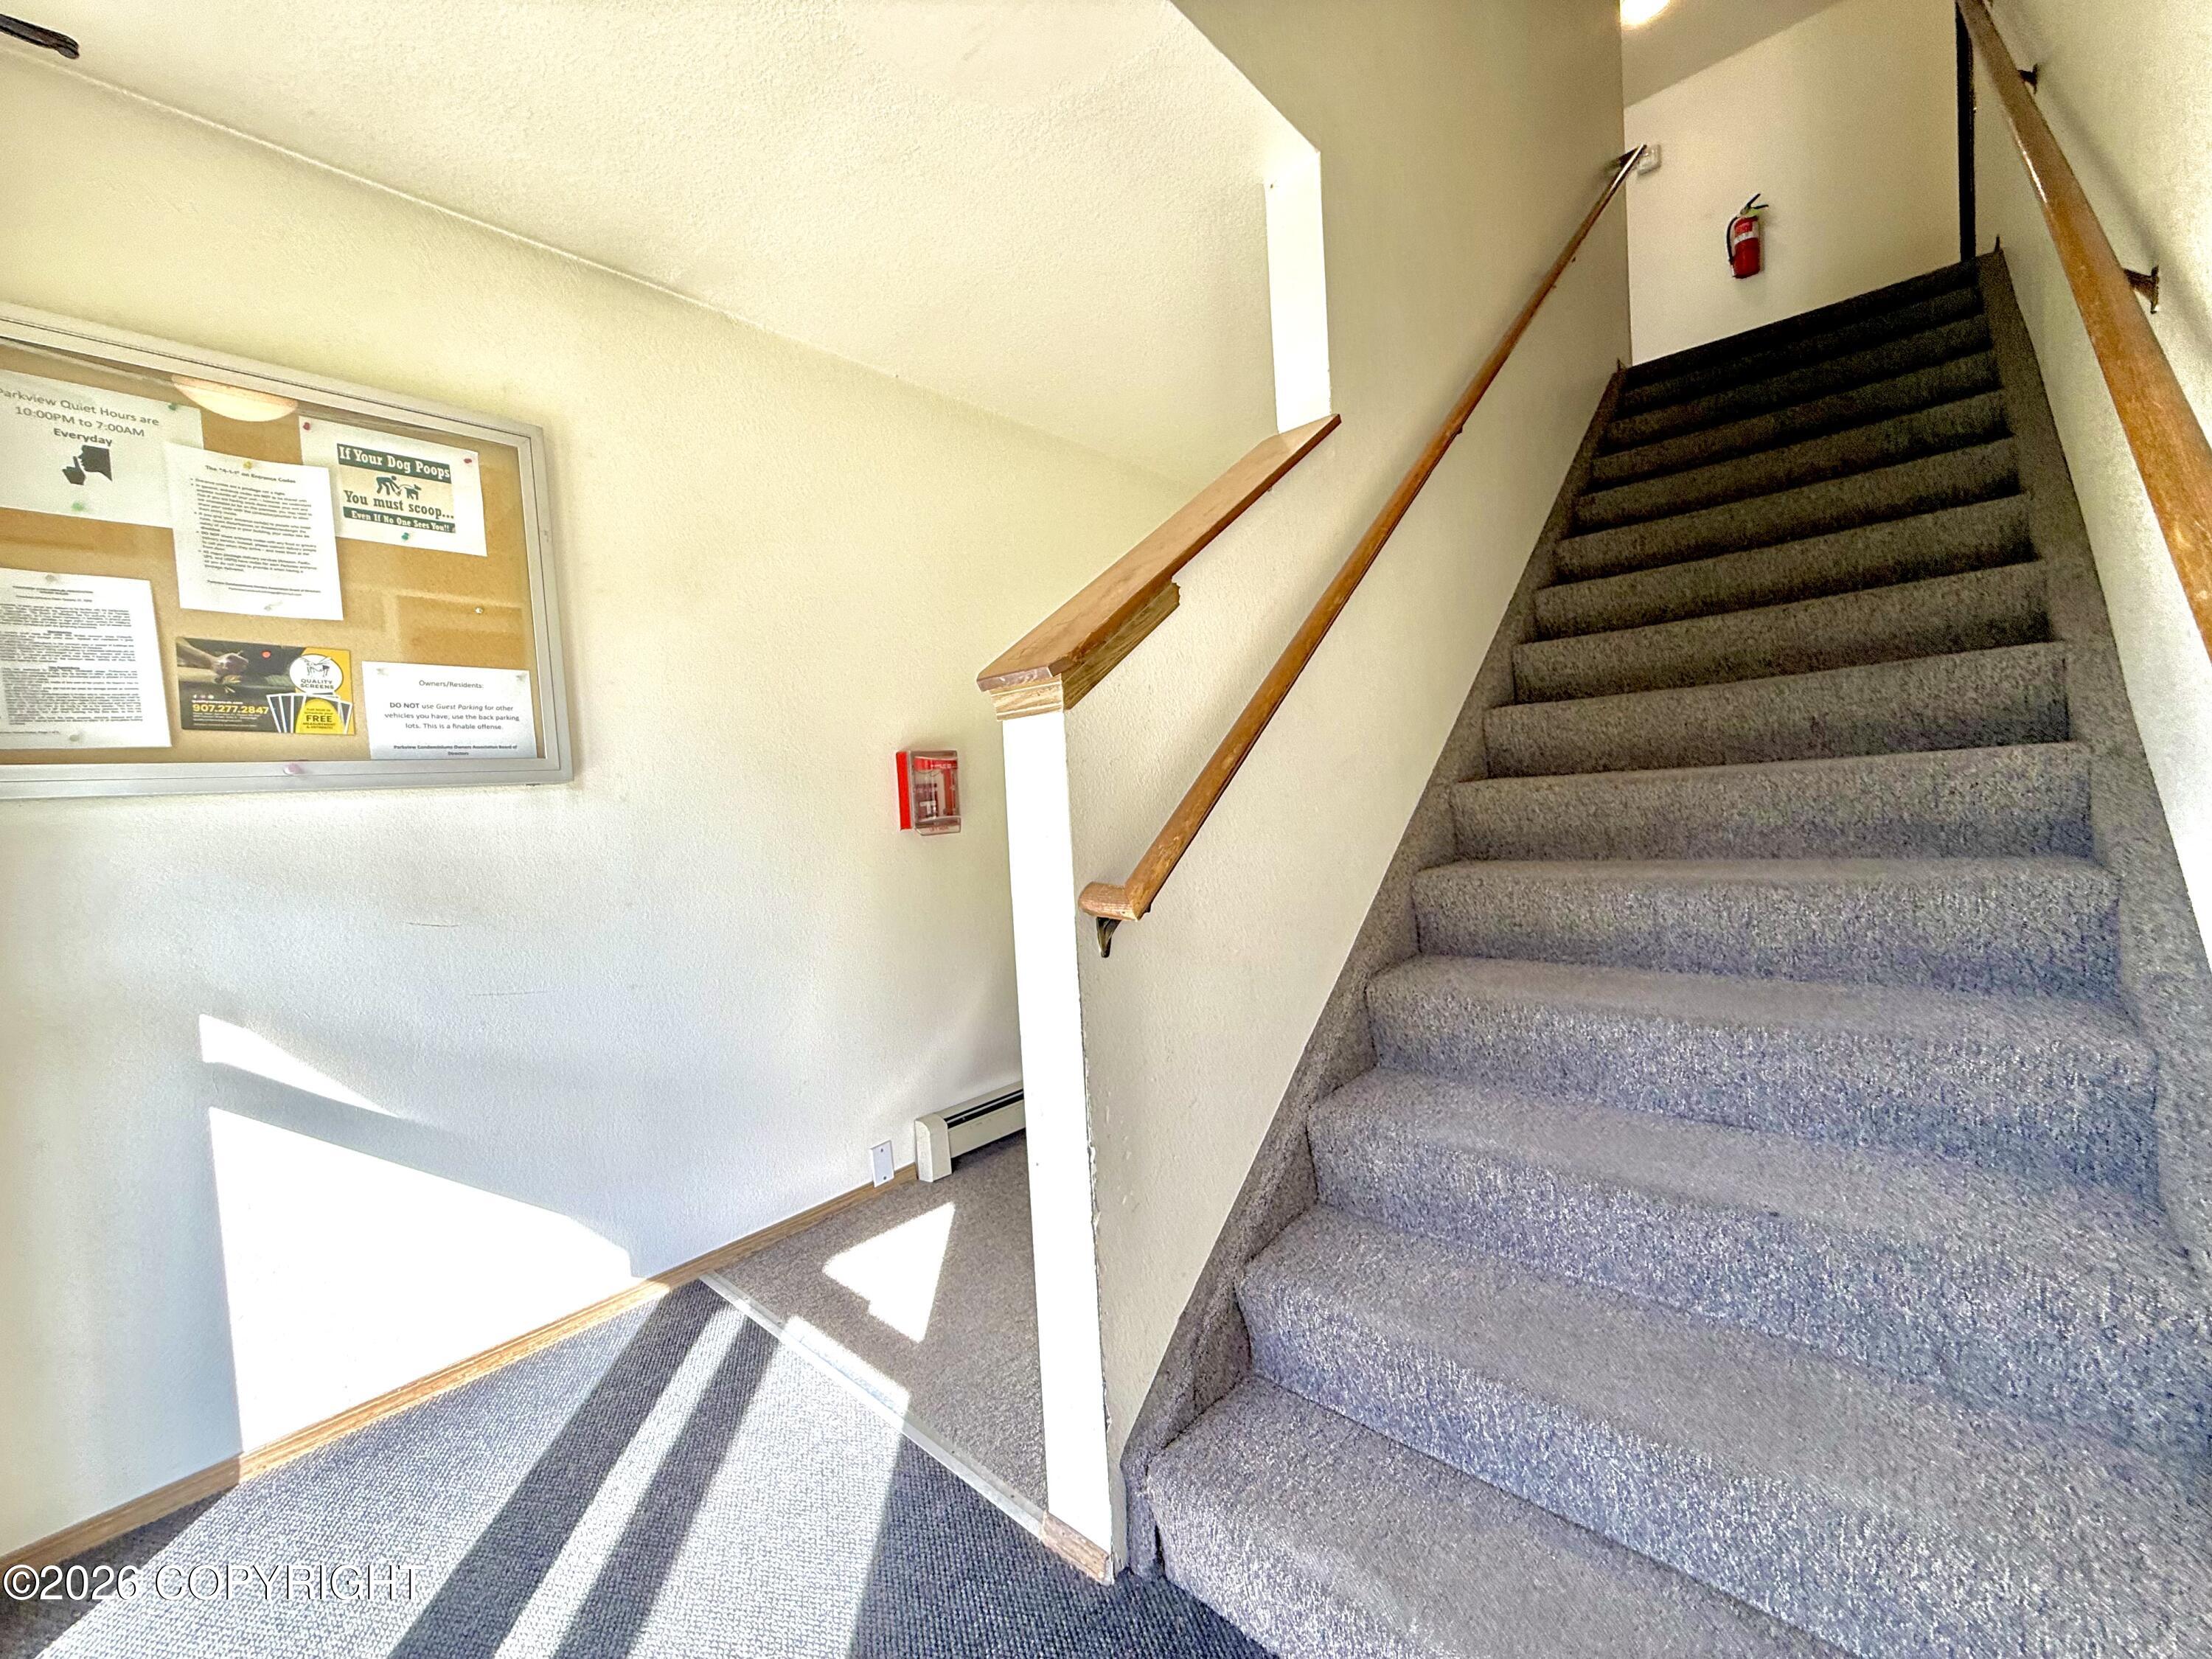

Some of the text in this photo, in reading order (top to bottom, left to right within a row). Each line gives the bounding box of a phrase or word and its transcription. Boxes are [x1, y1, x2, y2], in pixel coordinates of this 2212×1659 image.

[15, 406, 145, 437] 10:00PM to 7:00AM
[60, 400, 96, 414] Quiet
[100, 407, 136, 421] Hours
[140, 415, 159, 425] are
[54, 428, 112, 446] Everyday
[338, 446, 450, 480] If Your Dog Poops
[343, 490, 454, 519] You must scoop...
[351, 510, 372, 521] Even
[383, 515, 394, 524] No
[396, 517, 411, 526] One
[414, 520, 430, 529] Sees
[431, 522, 450, 532] You!!
[419, 680, 484, 689] Owners/Residents:
[192, 704, 268, 714] 907.277.2847
